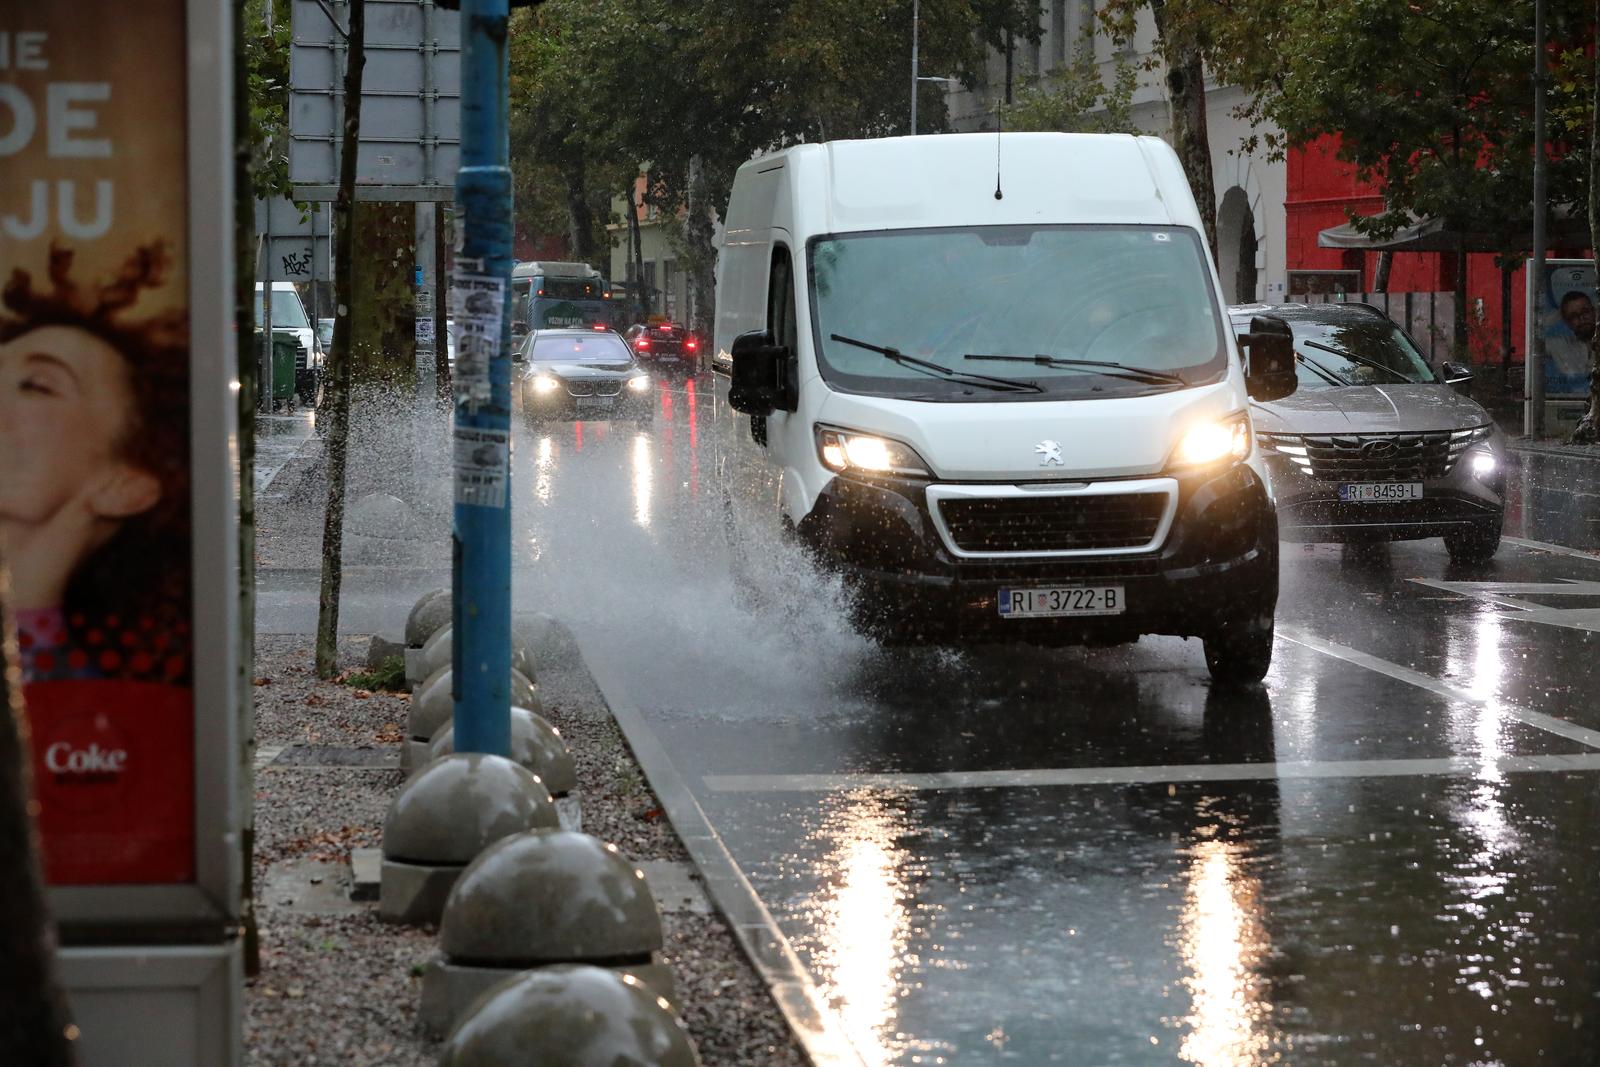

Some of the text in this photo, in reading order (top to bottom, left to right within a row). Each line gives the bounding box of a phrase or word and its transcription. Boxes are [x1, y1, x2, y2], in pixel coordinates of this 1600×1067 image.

[1348, 484, 1417, 499] RI 8459-L
[1012, 588, 1116, 611] RI 3722-B
[45, 741, 127, 773] Coke
